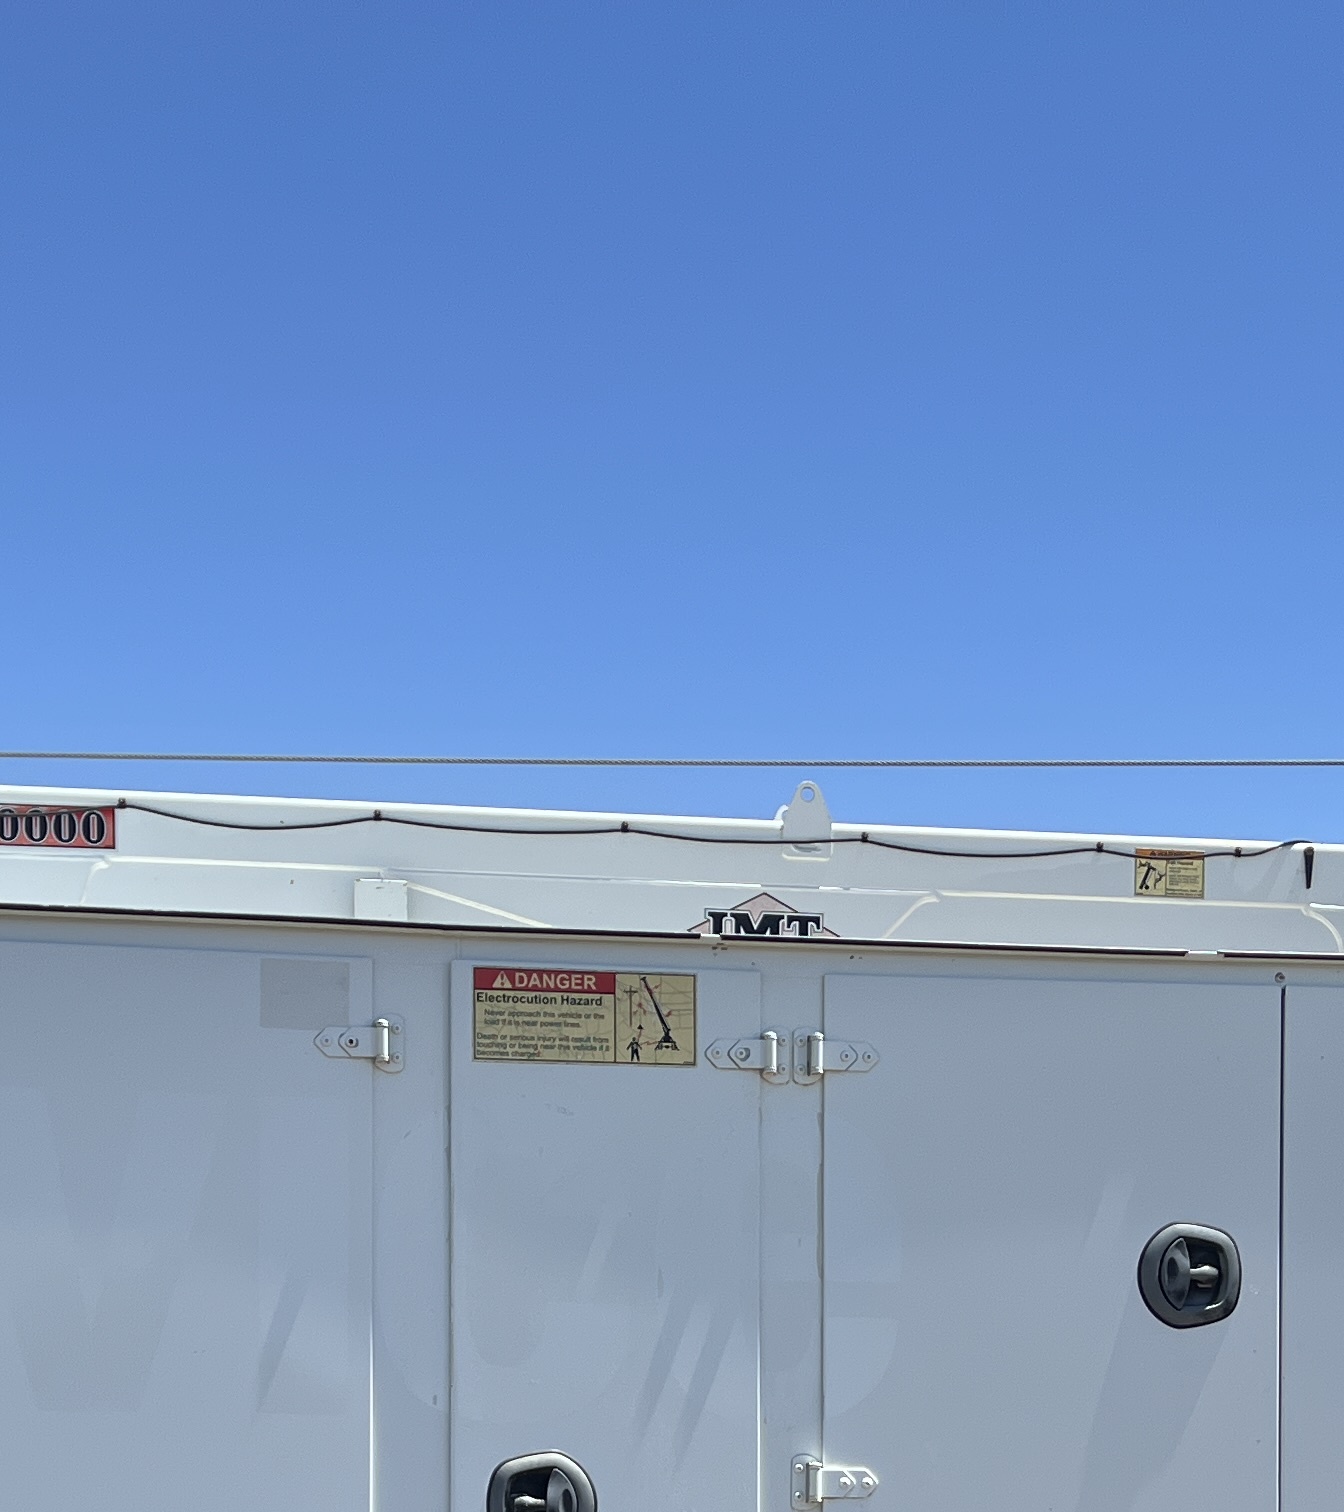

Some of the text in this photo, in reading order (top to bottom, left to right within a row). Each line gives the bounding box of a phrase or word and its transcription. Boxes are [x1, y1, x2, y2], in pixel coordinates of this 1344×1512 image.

[706, 910, 822, 936] IMT
[515, 972, 598, 990] DANGER
[476, 992, 603, 1007] Electrocution Hazard
[507, 1010, 541, 1018] approach
[593, 1012, 605, 1020] the
[477, 1032, 498, 1040] Death
[537, 1034, 556, 1043] injury
[593, 1036, 609, 1044] from
[477, 1041, 508, 1050] touching
[518, 1042, 538, 1051] being
[571, 1044, 597, 1052] vehicle
